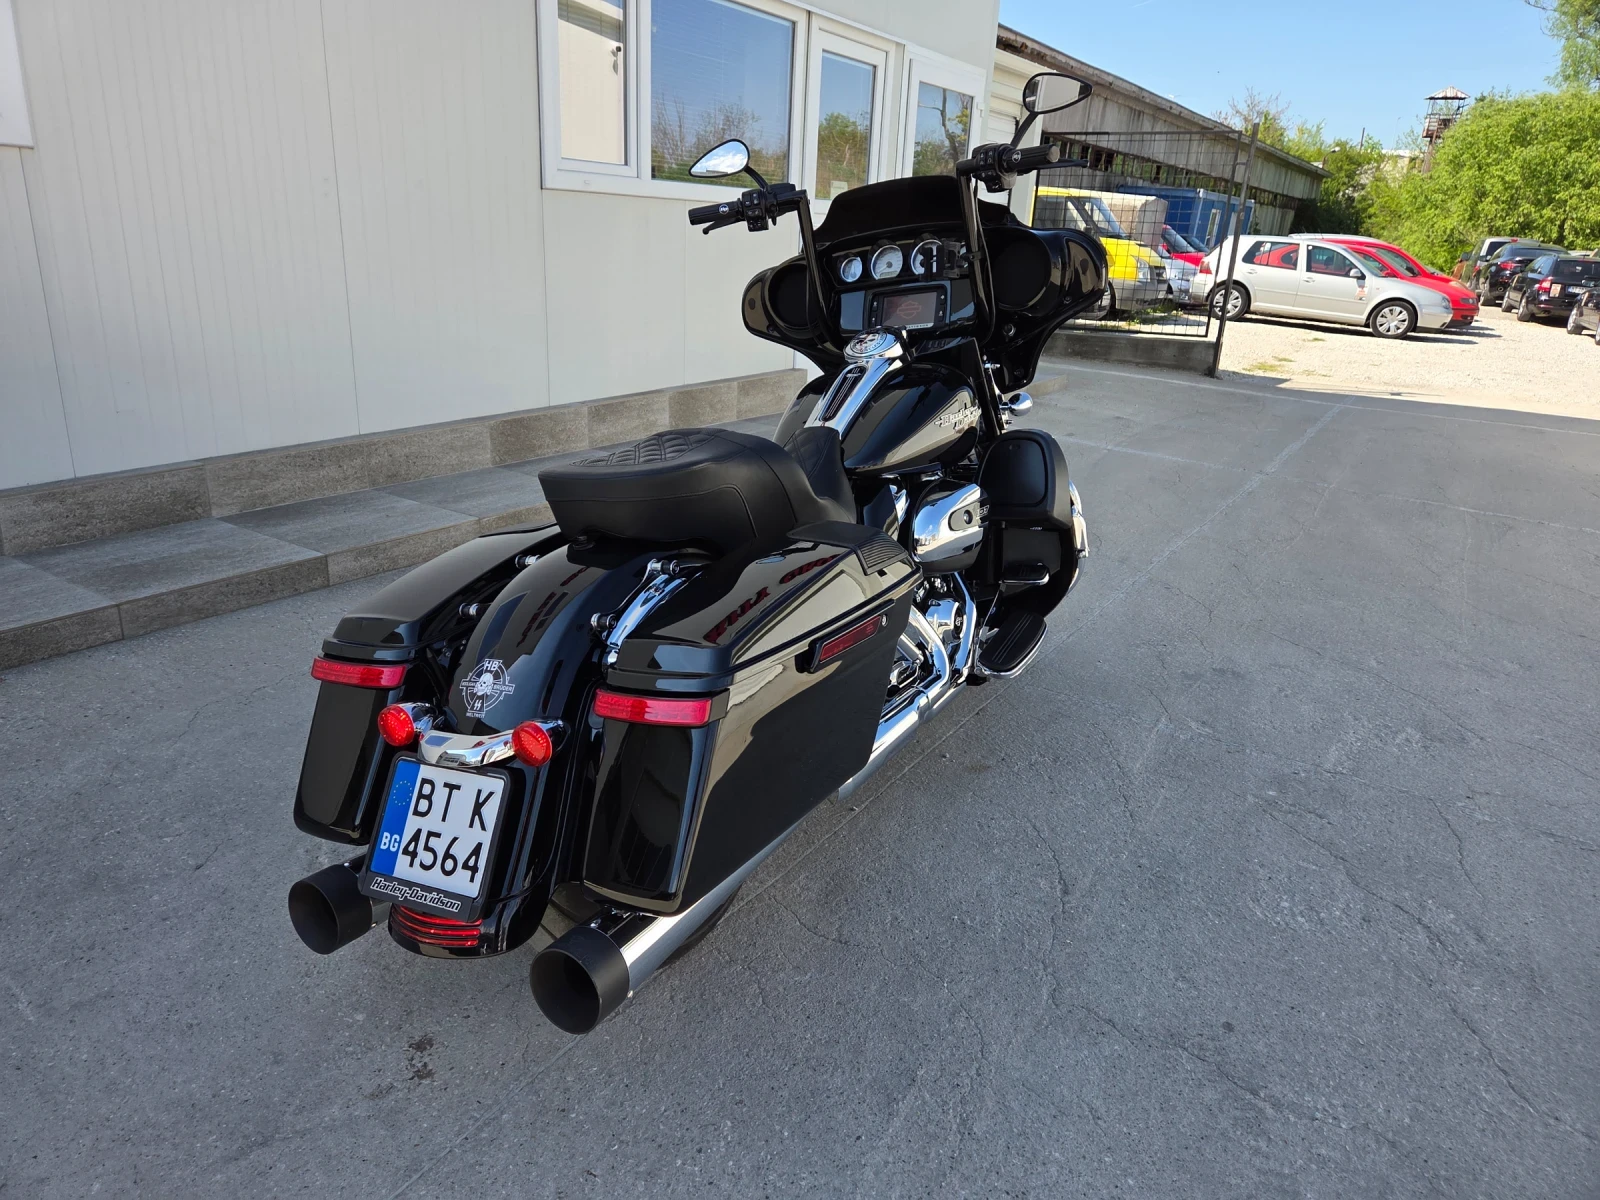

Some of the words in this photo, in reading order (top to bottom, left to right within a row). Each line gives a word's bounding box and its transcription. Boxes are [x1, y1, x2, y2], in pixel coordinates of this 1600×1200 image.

[484, 660, 499, 671] HB
[412, 777, 461, 823] BT
[468, 788, 495, 832] K
[380, 831, 400, 852] BG
[401, 827, 483, 883] 4564
[370, 876, 462, 913] Harley-Davidson
